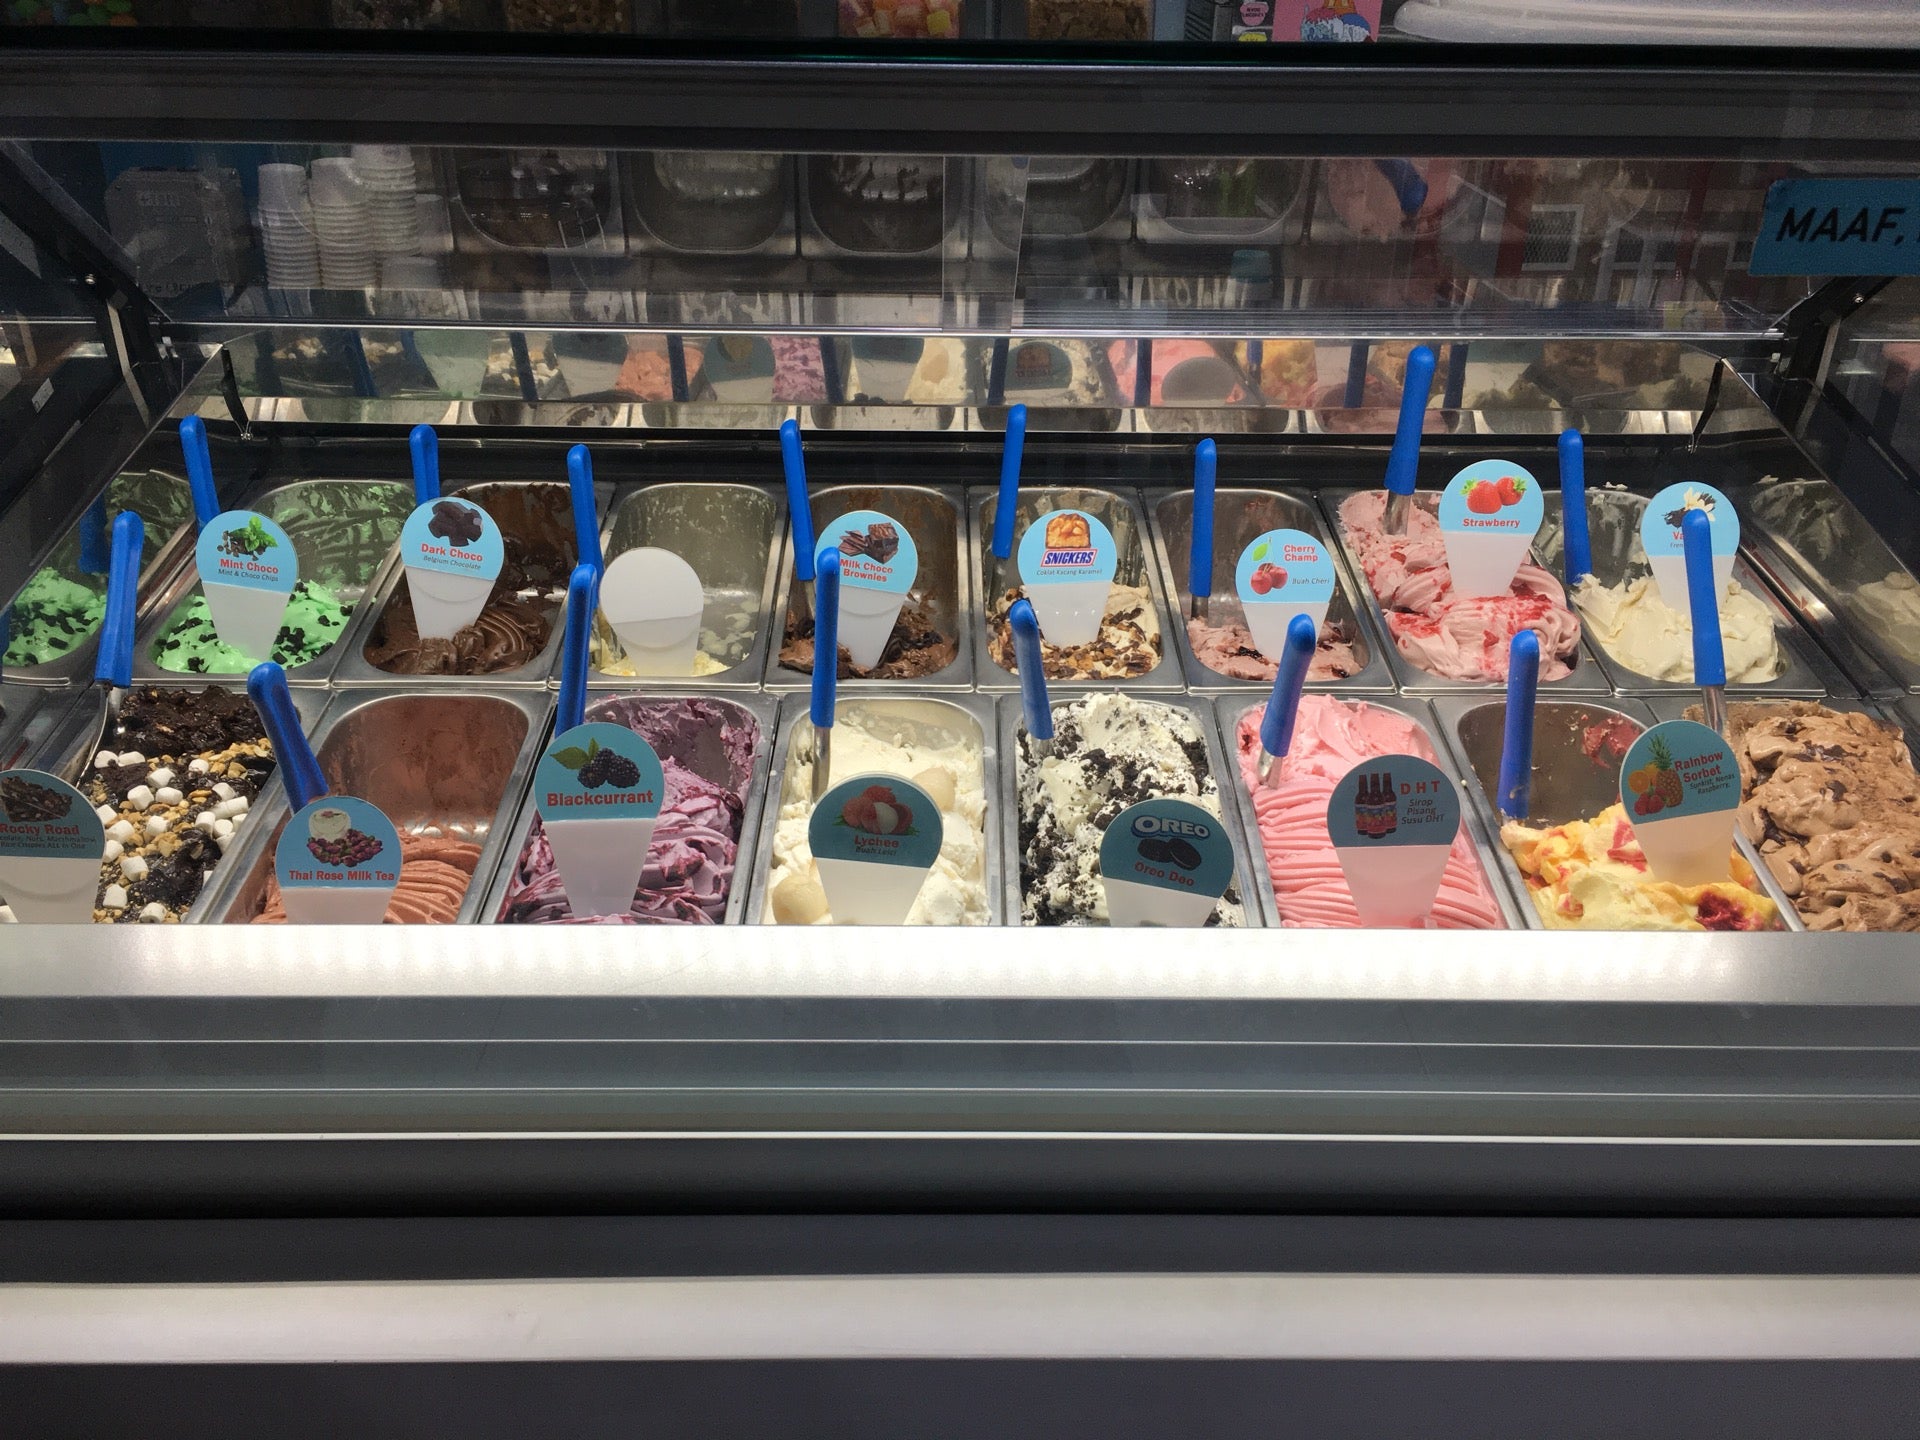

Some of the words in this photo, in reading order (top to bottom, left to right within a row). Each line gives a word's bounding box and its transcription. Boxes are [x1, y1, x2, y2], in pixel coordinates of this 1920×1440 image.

[1775, 207, 1905, 246] MAAF,
[1463, 518, 1520, 528] Strawberry
[421, 543, 446, 556] Dark
[449, 548, 483, 562] Choco
[1283, 544, 1316, 554] Cherry
[423, 555, 449, 565] Belgium
[450, 559, 481, 570] Chocolate
[1044, 551, 1094, 565] SNICKERS
[1284, 553, 1319, 563] Champ
[219, 558, 244, 570] Mint
[246, 561, 279, 574] Choco
[840, 558, 861, 569] Milk
[863, 562, 893, 574] Choco
[218, 568, 233, 577] Mint
[241, 571, 261, 580] Choco
[261, 574, 279, 582] Chips
[843, 568, 888, 582] Brownies
[1674, 751, 1723, 772] Rainbow
[1683, 765, 1722, 783] Sorbet
[547, 790, 654, 807] Blackcurrant
[1409, 799, 1433, 807] Sirop
[1406, 807, 1437, 816] Pisang
[1401, 816, 1423, 825] Susu
[1425, 813, 1446, 823] DHT
[0, 823, 40, 836] Rocky
[44, 824, 80, 835] Road
[1131, 815, 1210, 838] OREO
[854, 835, 899, 848] Lychee
[289, 870, 313, 880] Thai
[316, 870, 344, 880] Rose
[347, 870, 372, 880] Milk
[375, 870, 395, 881] Tea
[1134, 861, 1165, 878] Oreo
